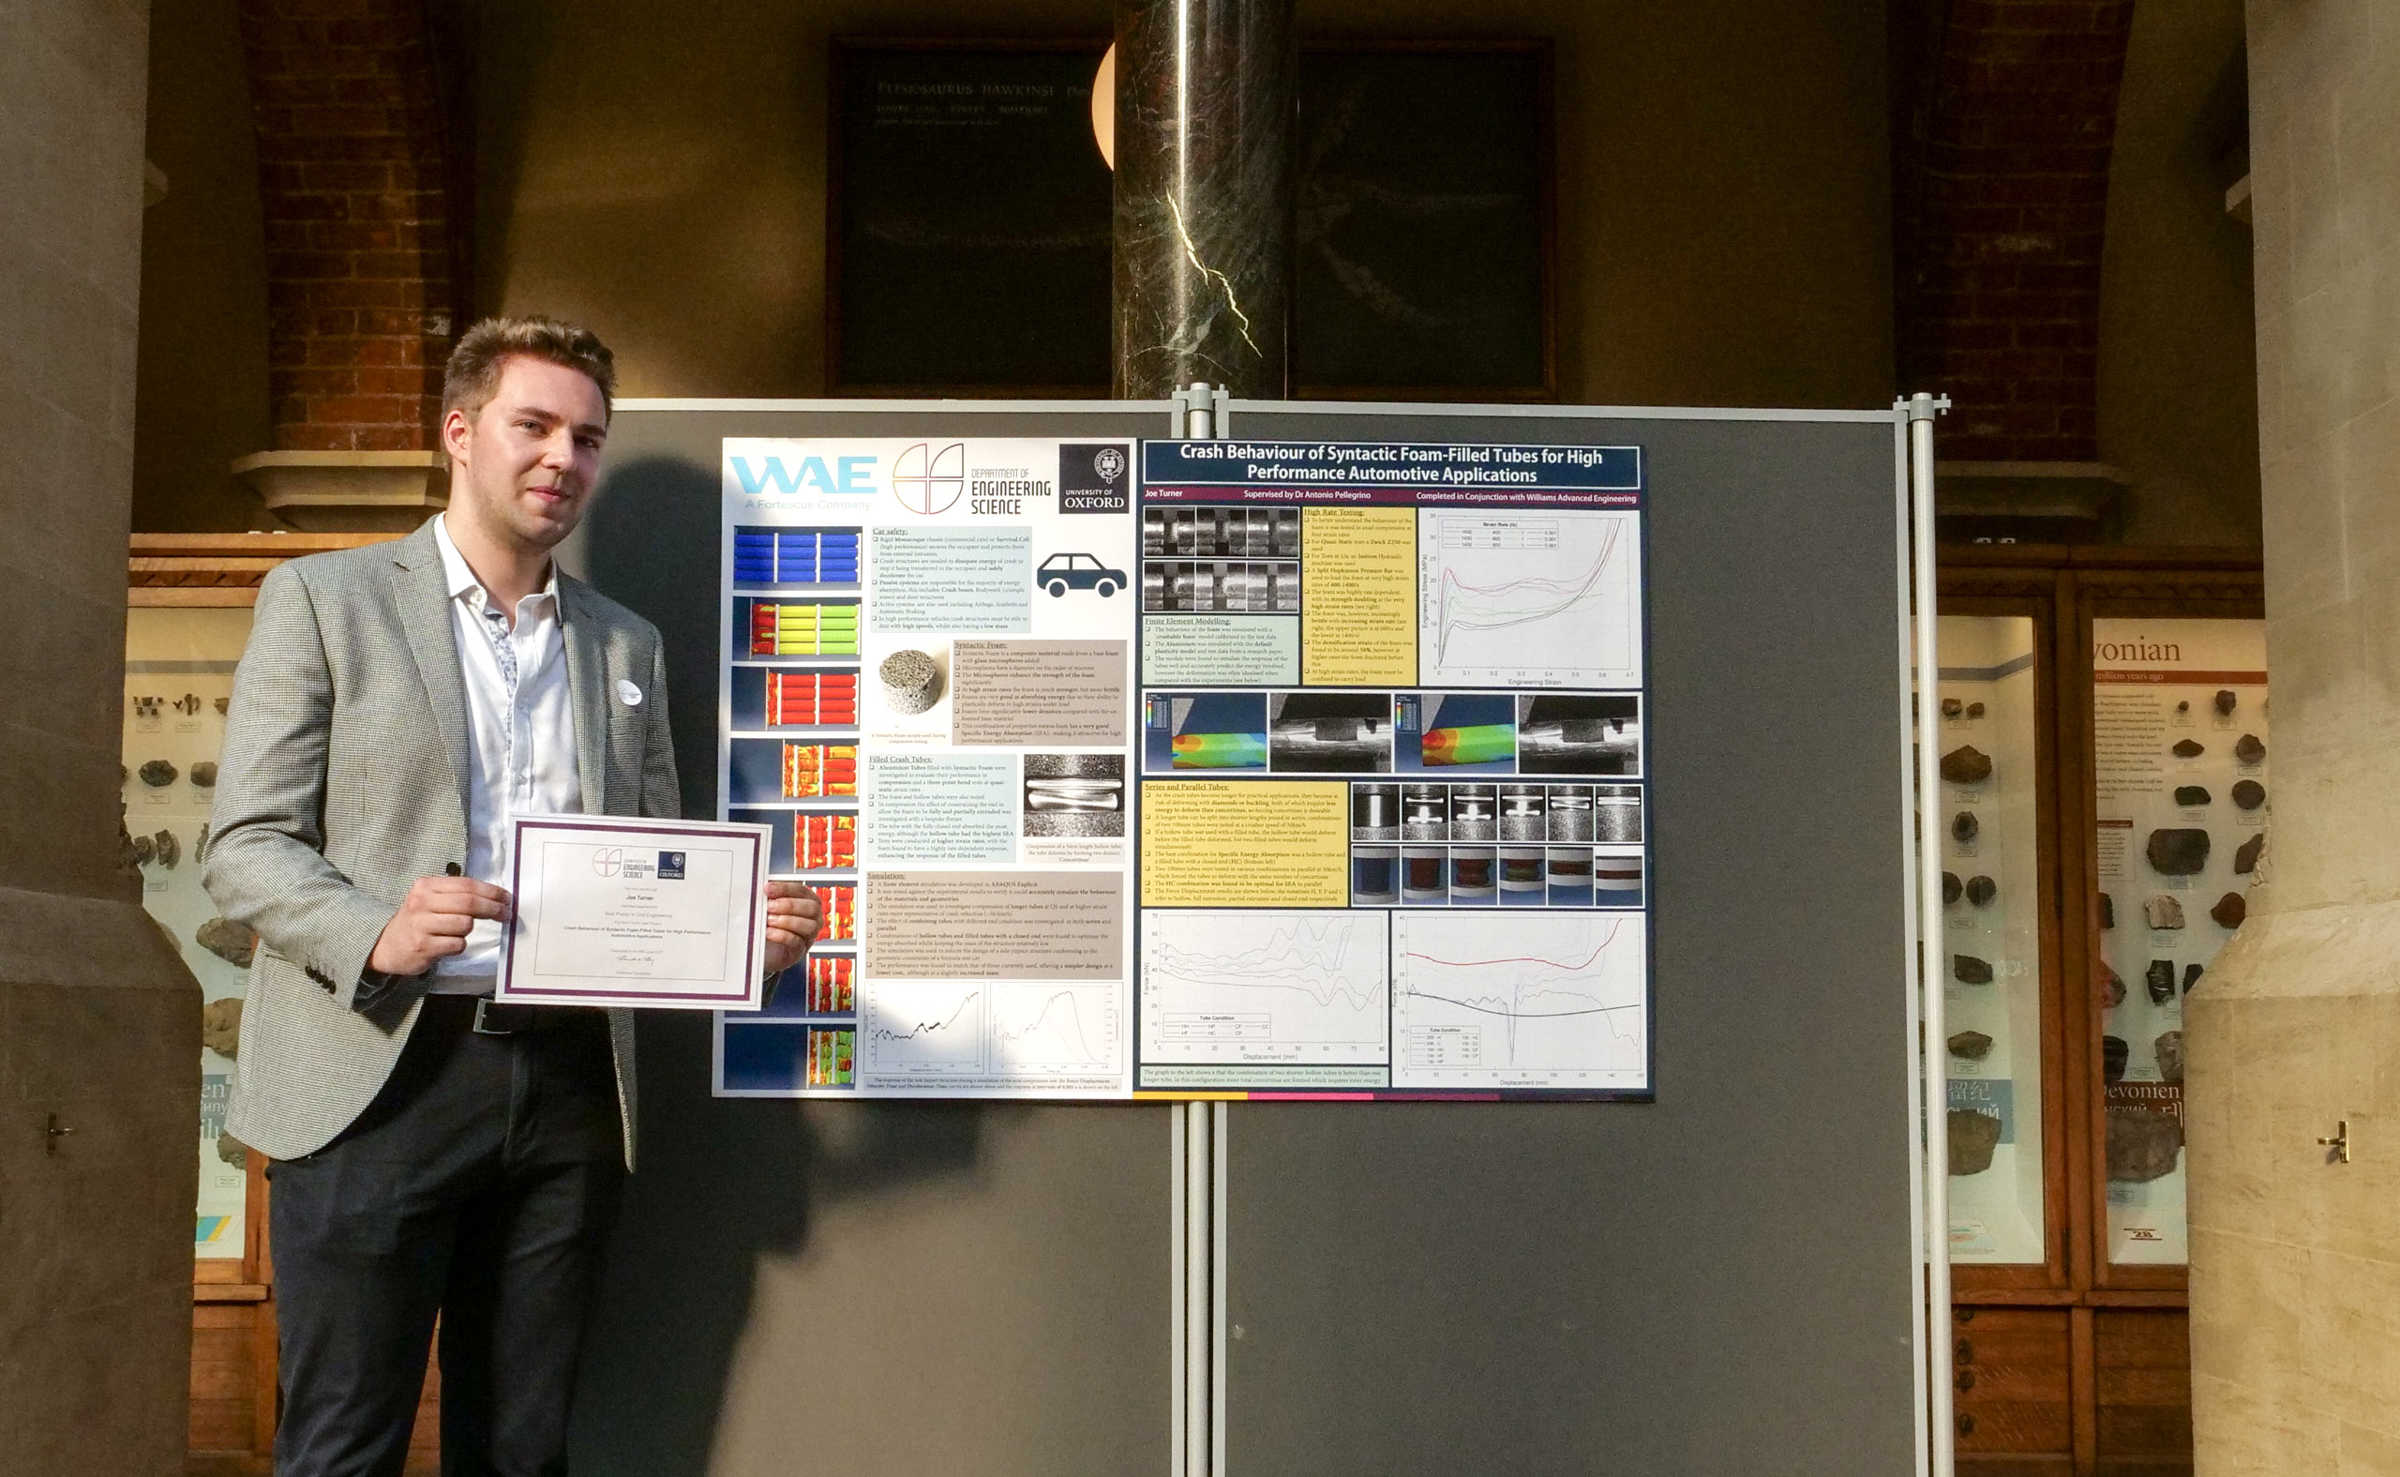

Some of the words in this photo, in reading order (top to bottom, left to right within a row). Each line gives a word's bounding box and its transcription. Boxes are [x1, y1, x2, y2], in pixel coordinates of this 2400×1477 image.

[1180, 444, 1223, 459] Crash
[1227, 445, 1306, 461] Behaviour
[1308, 446, 1324, 461] of
[1327, 447, 1397, 465] Syntactic
[1400, 447, 1490, 463] Foam-Filled
[1492, 448, 1538, 465] Tubes
[1541, 449, 1563, 466] for
[1566, 450, 1603, 470] High
[729, 455, 878, 495] WAE
[971, 468, 1018, 479] DEPARTMENT
[1020, 468, 1030, 479] OF
[1247, 464, 1346, 480] Performance
[1348, 465, 1439, 482] Automotive
[1442, 467, 1538, 485] Applications
[971, 481, 1052, 497] ENGINEERING
[1064, 497, 1125, 509] OXFORD
[1145, 489, 1158, 498] Joe
[1159, 489, 1183, 498] Turner
[1243, 490, 1283, 500] Supervised
[1284, 490, 1293, 500] by
[1294, 490, 1304, 499] Dr
[1305, 491, 1334, 500] Antonio
[1335, 491, 1371, 501] Pellegrino
[1416, 492, 1456, 503] Completed
[1458, 493, 1464, 501] in
[1465, 493, 1509, 503] Conjunction
[1510, 493, 1525, 502] with
[1526, 494, 1556, 503] Williams
[1558, 495, 1593, 504] Advanced
[1593, 496, 1637, 507] Engineering
[971, 499, 1022, 515] SCIENCE
